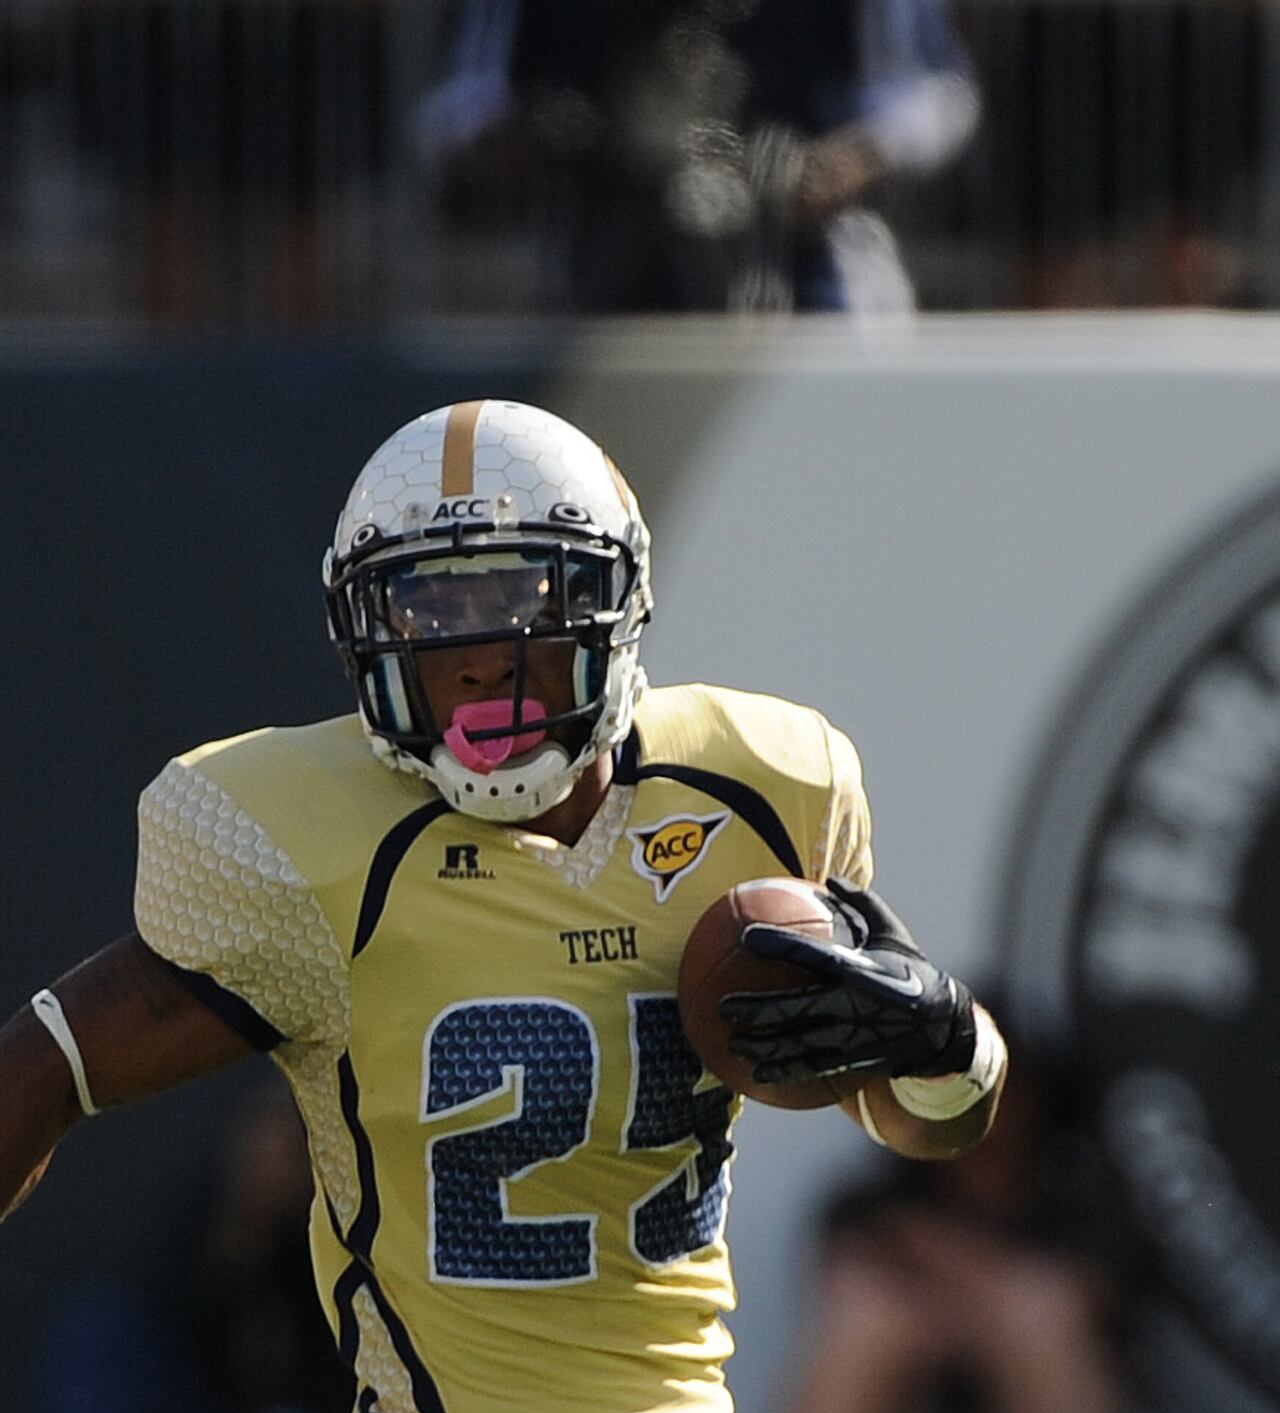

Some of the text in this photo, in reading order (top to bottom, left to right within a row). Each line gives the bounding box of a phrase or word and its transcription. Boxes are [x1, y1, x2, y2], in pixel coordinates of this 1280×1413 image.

[432, 499, 490, 521] ACC
[445, 844, 480, 868] R
[651, 831, 701, 864] ACC
[559, 926, 639, 965] TECH
[420, 992, 734, 1287] 25
